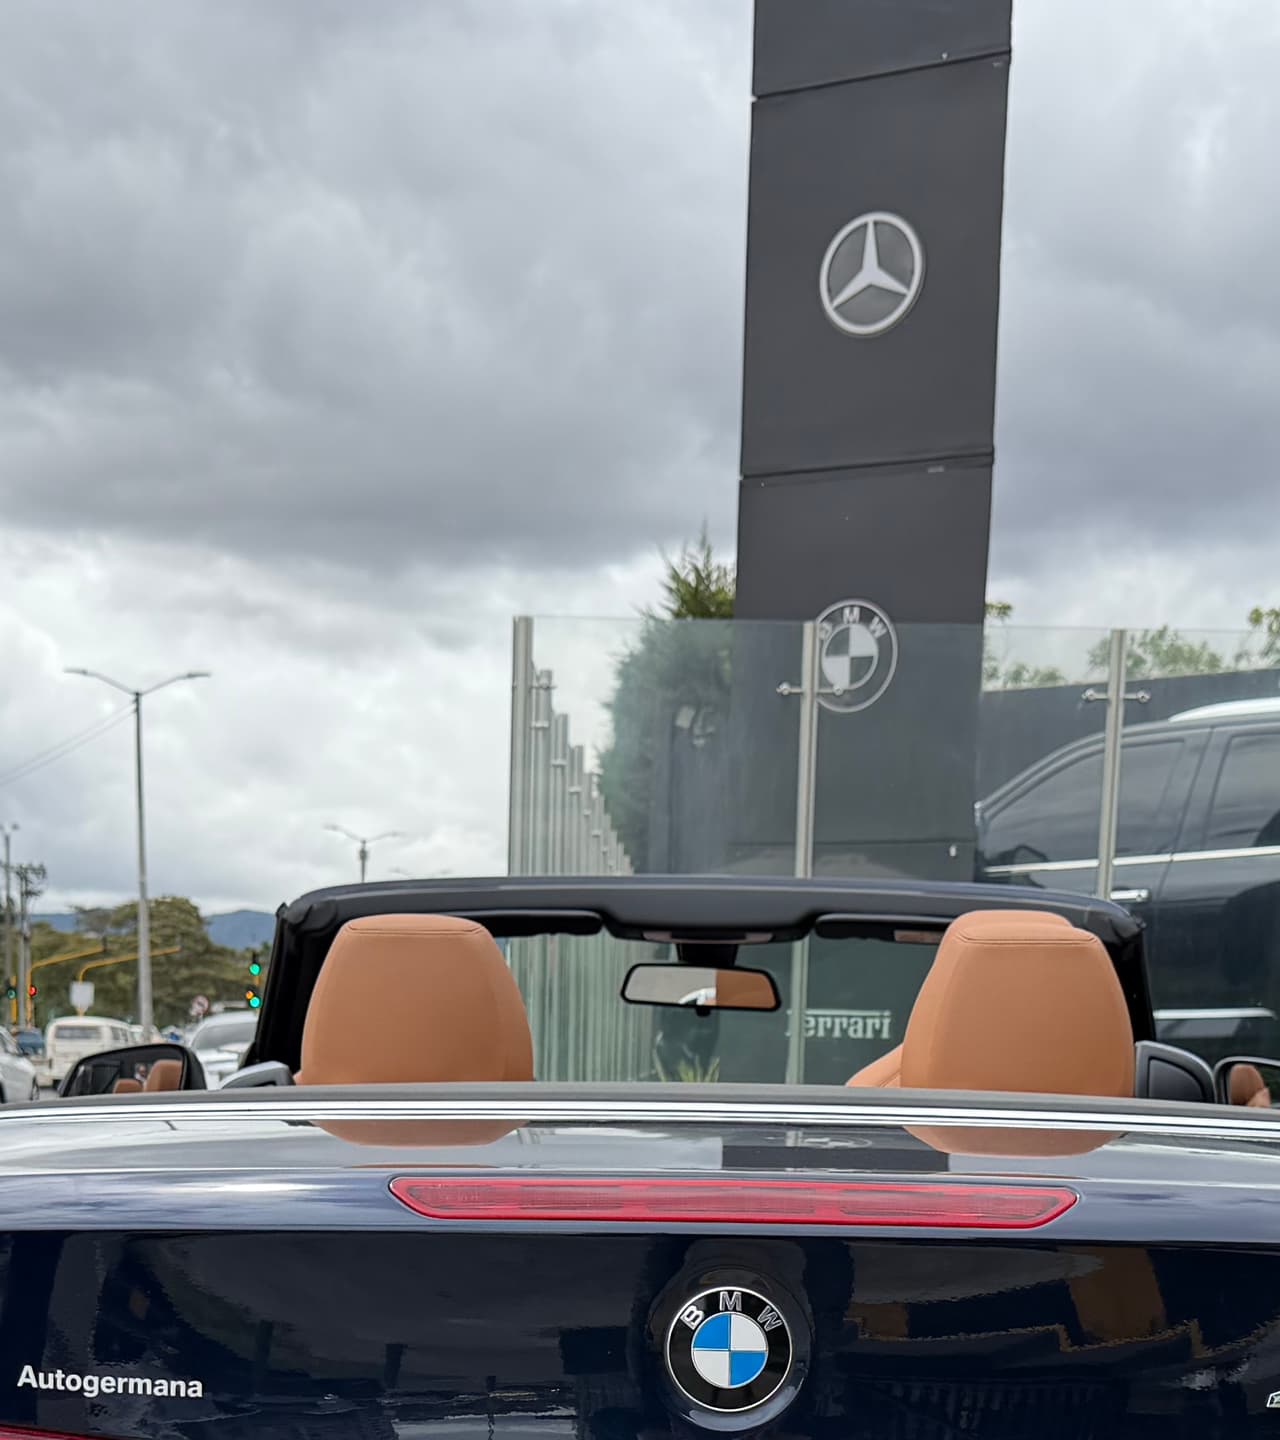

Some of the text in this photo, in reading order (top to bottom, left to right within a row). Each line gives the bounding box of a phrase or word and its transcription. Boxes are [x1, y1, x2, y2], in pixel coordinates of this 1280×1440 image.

[784, 1009, 891, 1039] errari
[680, 1291, 782, 1331] BMW
[17, 1364, 204, 1398] Autogermana
